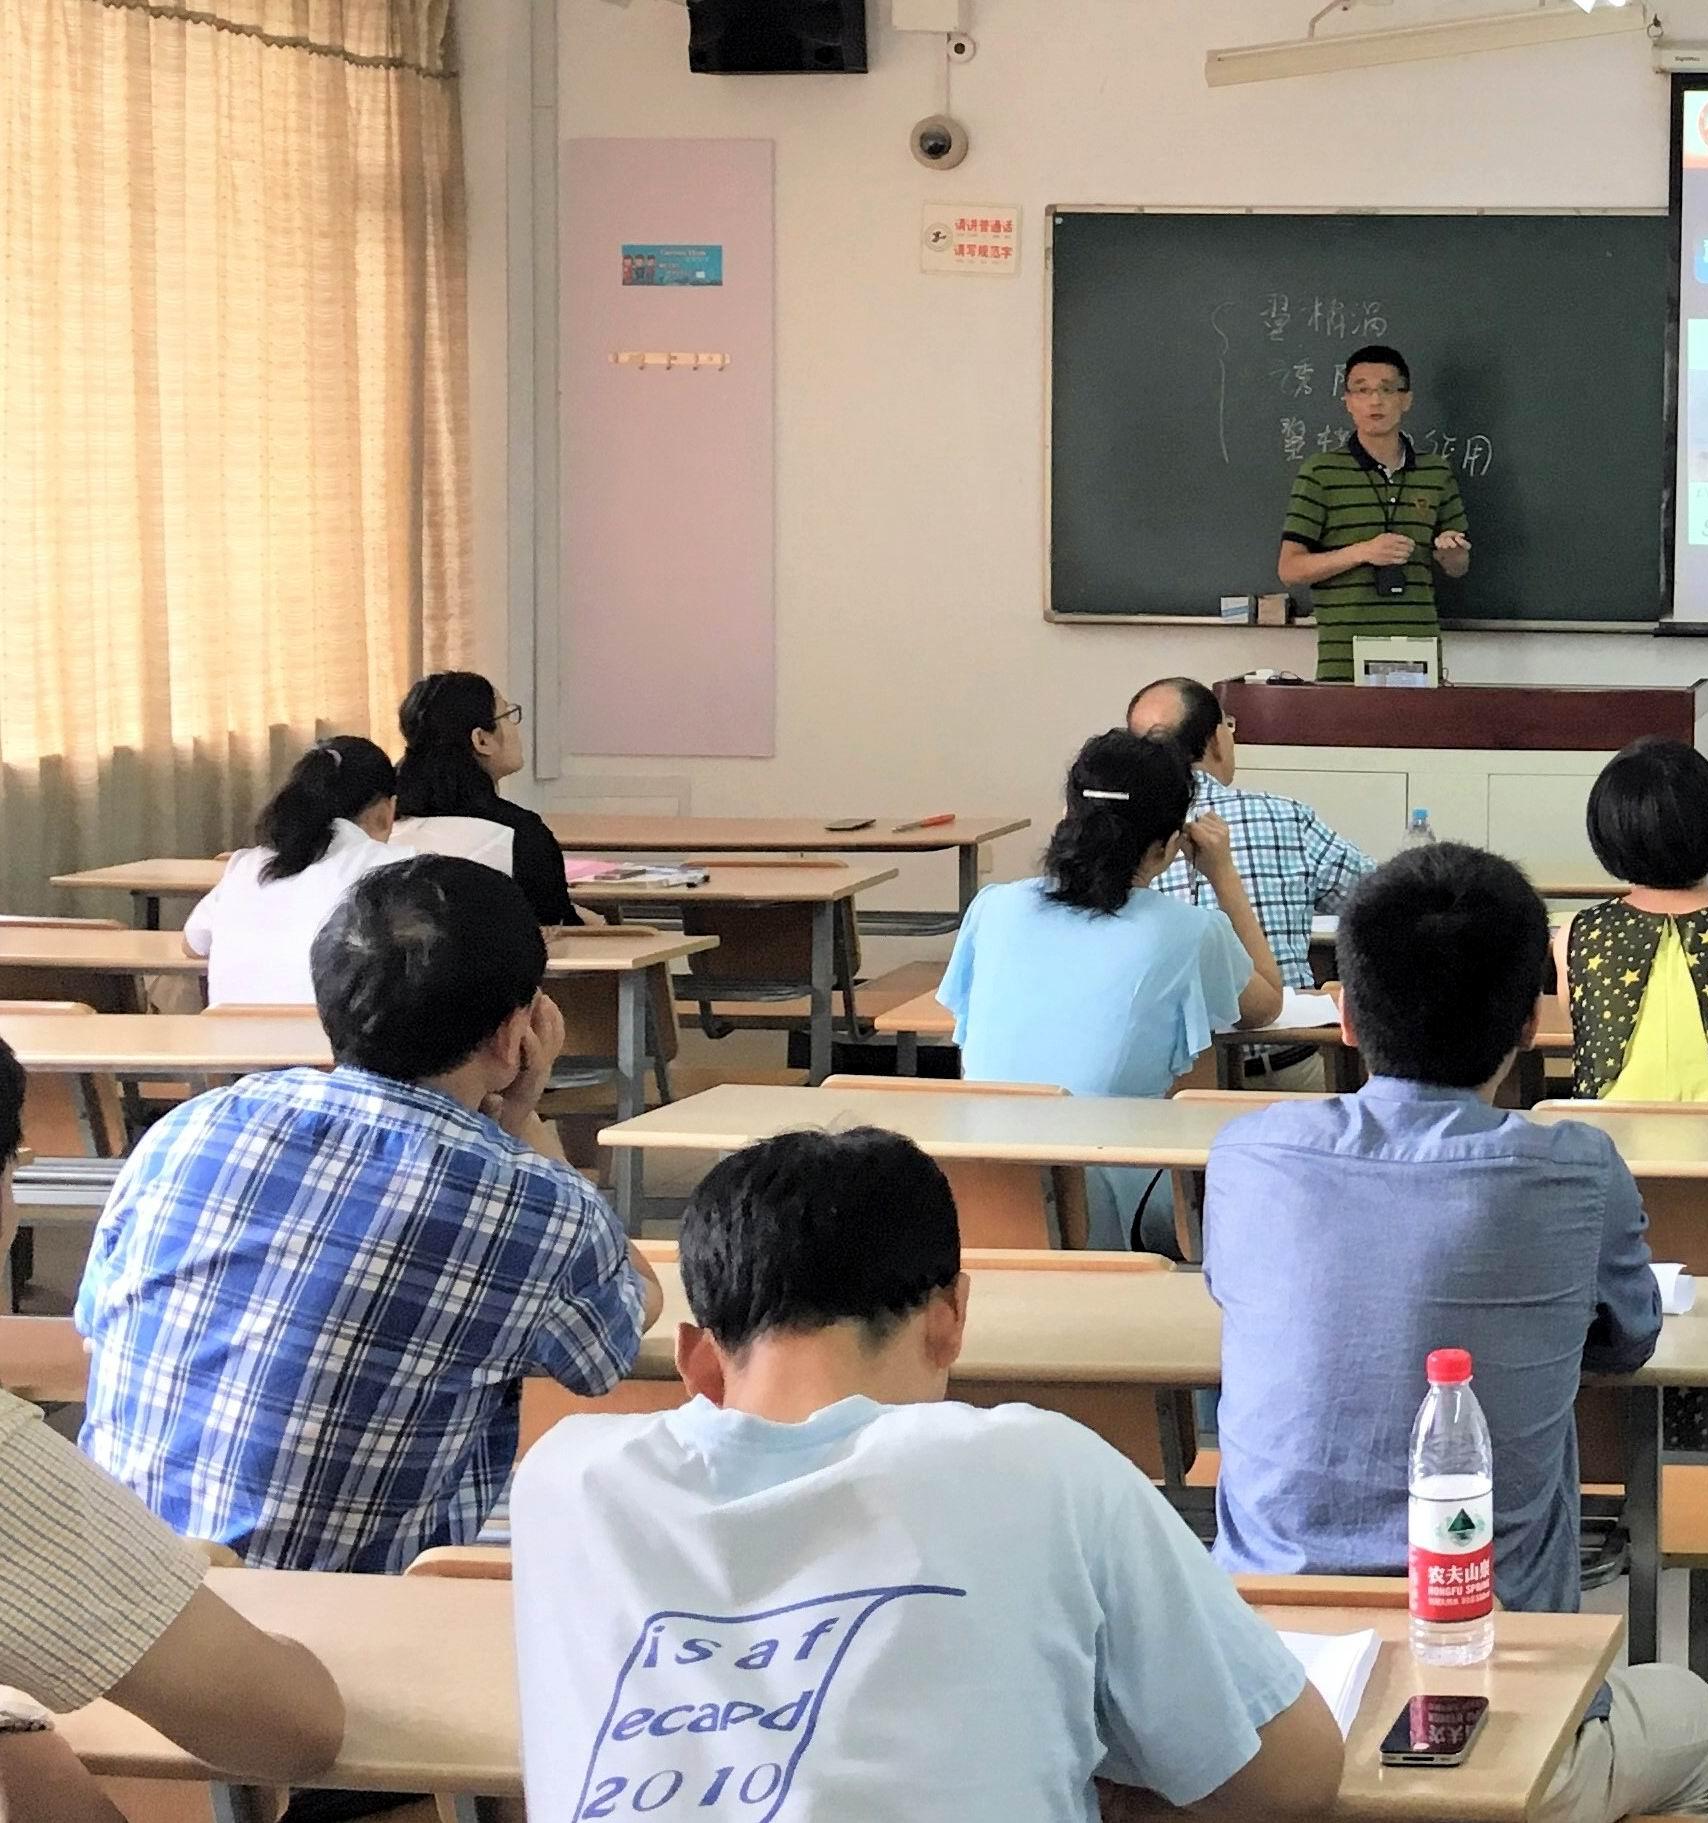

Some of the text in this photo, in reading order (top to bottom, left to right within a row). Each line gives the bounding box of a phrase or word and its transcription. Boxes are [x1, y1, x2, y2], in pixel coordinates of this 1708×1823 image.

[642, 1616, 840, 1669] isaf
[611, 1689, 815, 1742] ecapd
[581, 1762, 784, 1819] 2010
